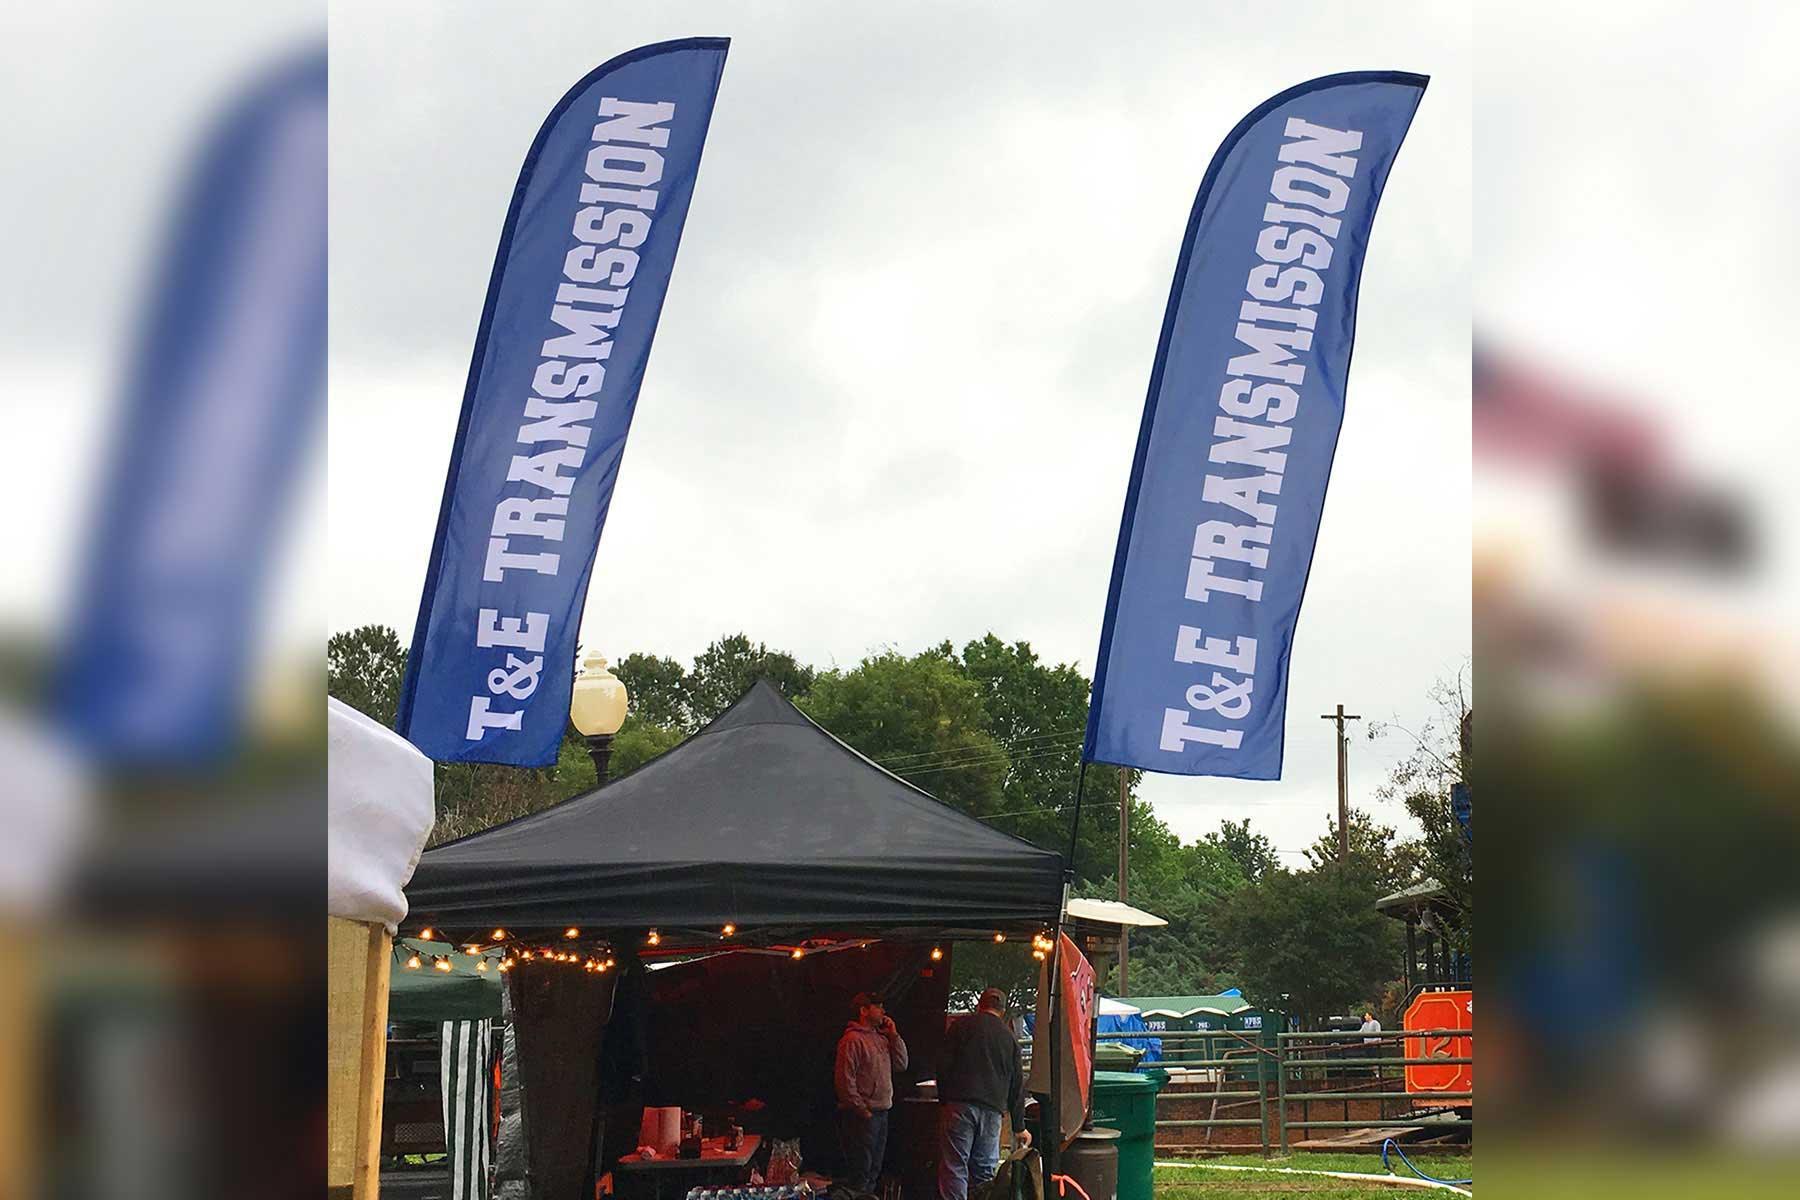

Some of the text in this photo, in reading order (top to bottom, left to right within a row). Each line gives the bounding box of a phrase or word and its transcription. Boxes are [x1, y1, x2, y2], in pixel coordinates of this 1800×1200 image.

[466, 97, 676, 741] T&E TRANSMISSION
[1160, 116, 1364, 753] T&E TRANSMISSION
[1418, 1027, 1454, 1059] 12
